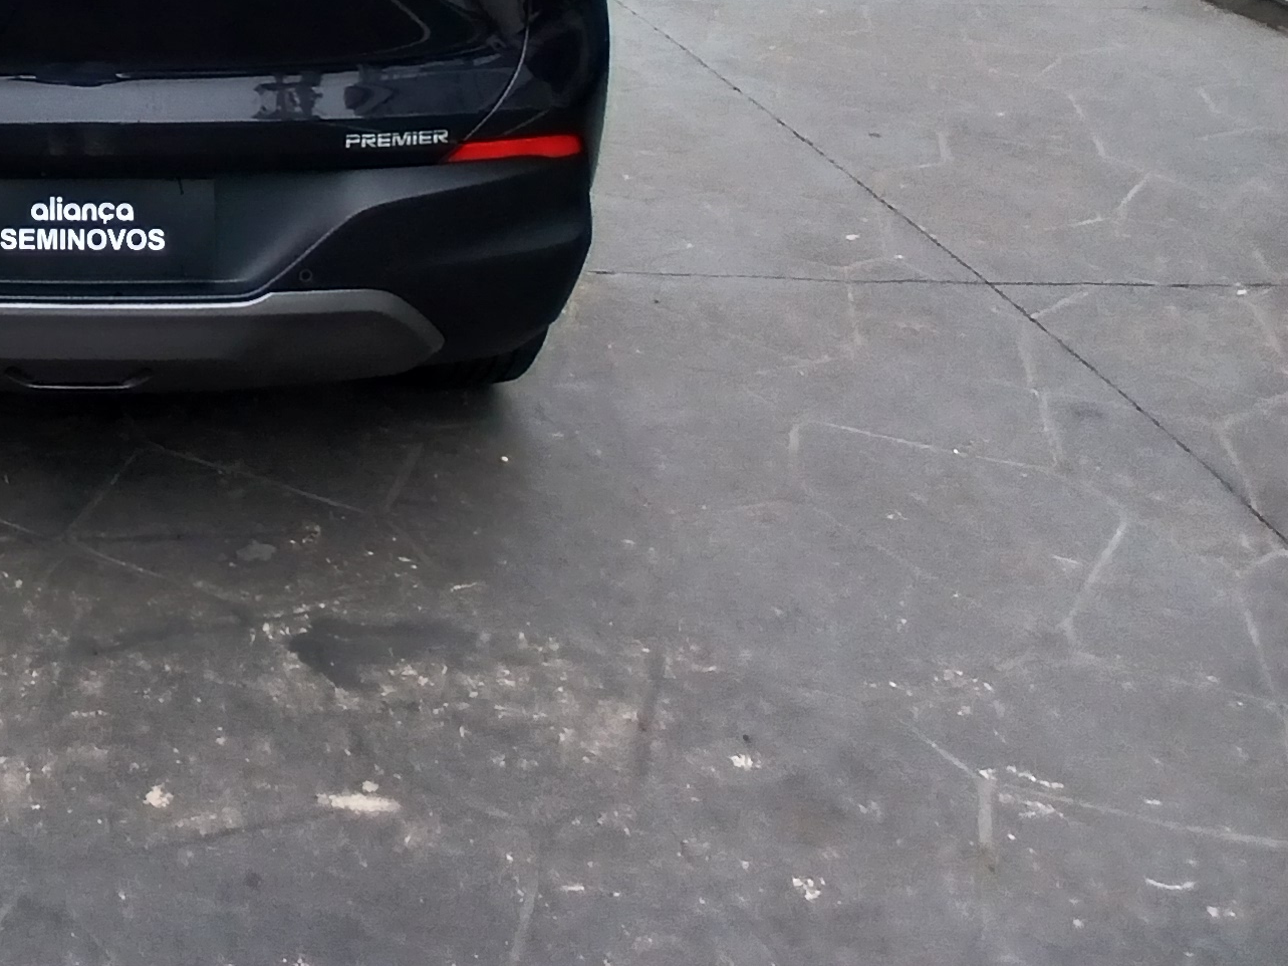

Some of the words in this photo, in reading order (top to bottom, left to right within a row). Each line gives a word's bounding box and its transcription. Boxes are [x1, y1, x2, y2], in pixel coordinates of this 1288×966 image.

[345, 129, 449, 149] PREMIER
[30, 196, 135, 225] aliança
[0, 227, 166, 252] SEMINOVOS
